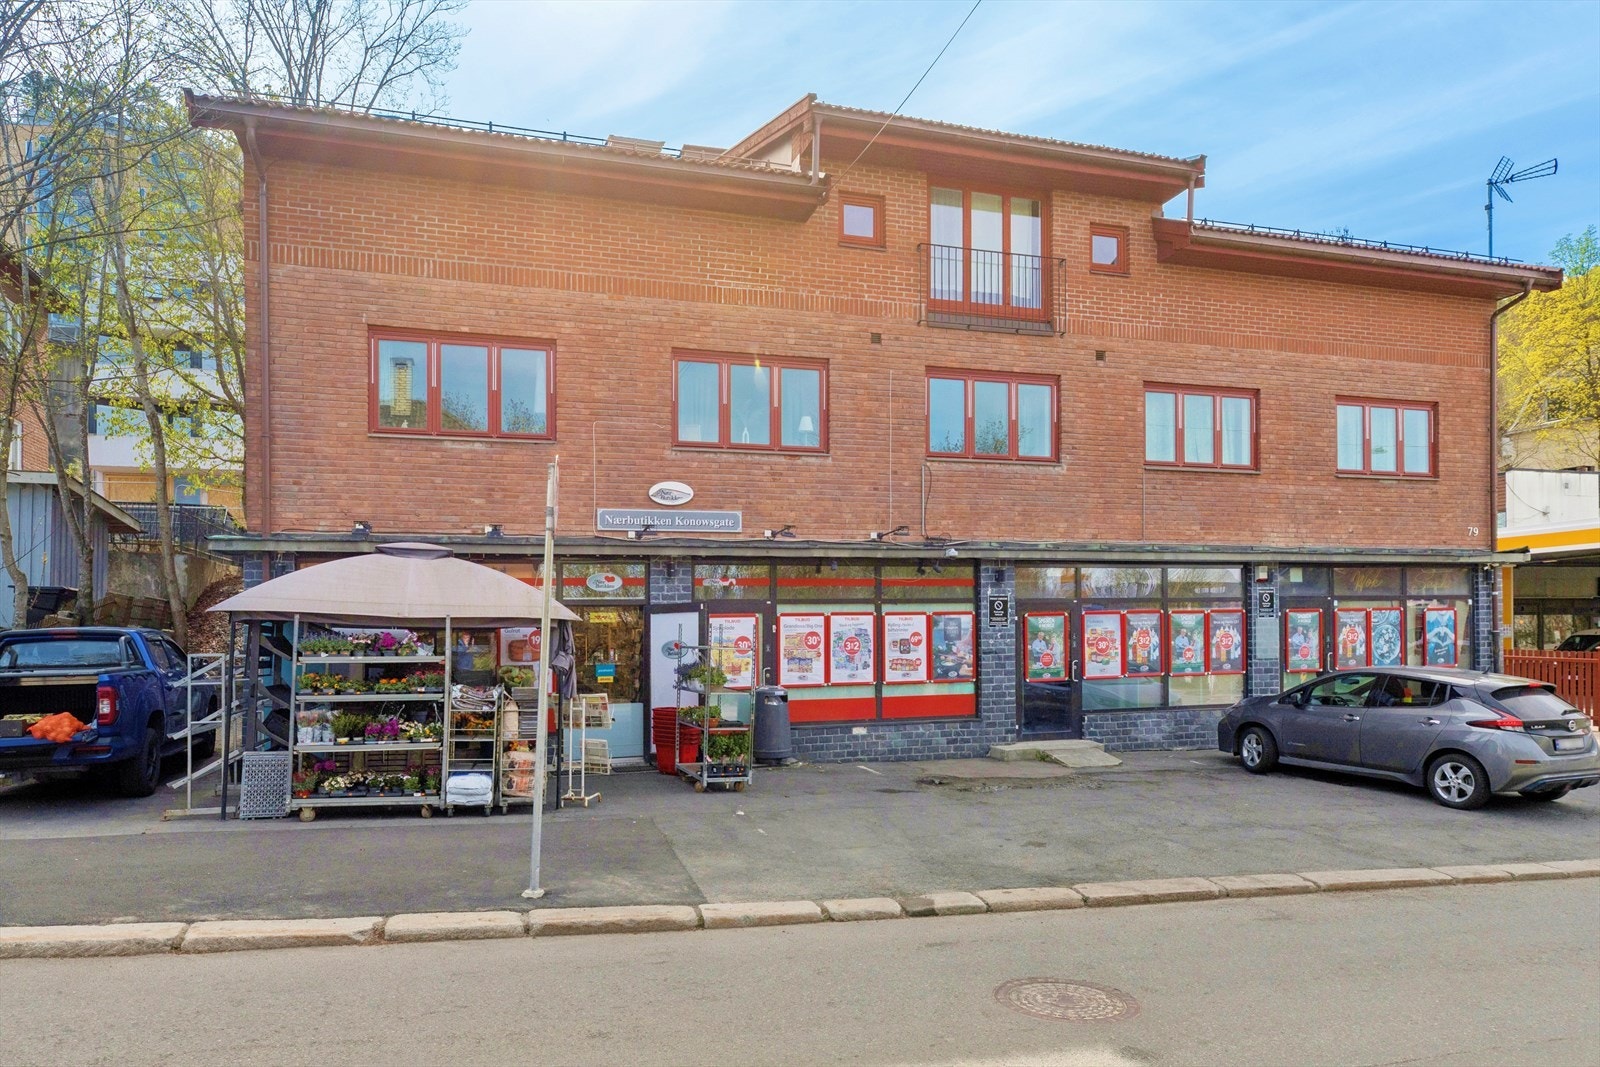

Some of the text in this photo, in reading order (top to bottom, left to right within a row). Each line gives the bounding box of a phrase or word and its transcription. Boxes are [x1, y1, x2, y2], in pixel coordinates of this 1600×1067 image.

[604, 514, 735, 528] Nærbutikken Konowsgate
[1467, 526, 1479, 537] 79
